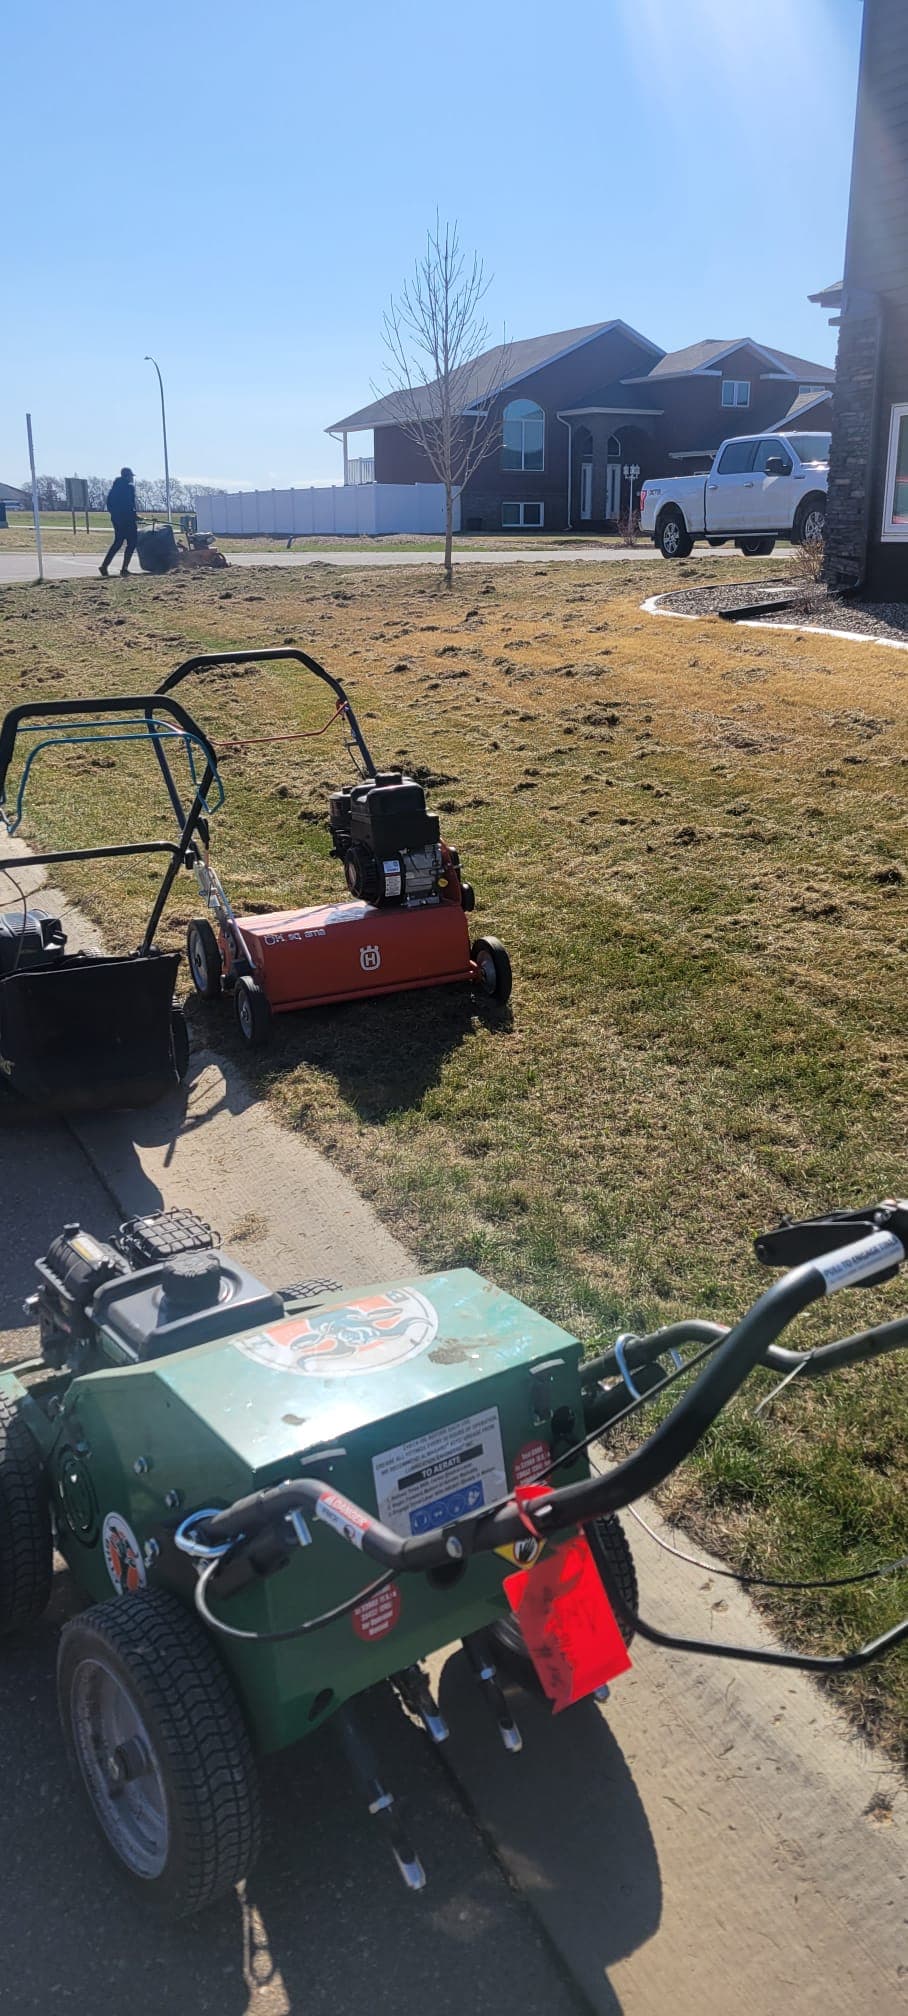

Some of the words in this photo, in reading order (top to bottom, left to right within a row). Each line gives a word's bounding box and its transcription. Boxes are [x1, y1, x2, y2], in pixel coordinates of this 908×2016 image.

[421, 1467, 434, 1479] TO
[433, 1456, 461, 1474] AERATE
[333, 1498, 366, 1526] DANGER
